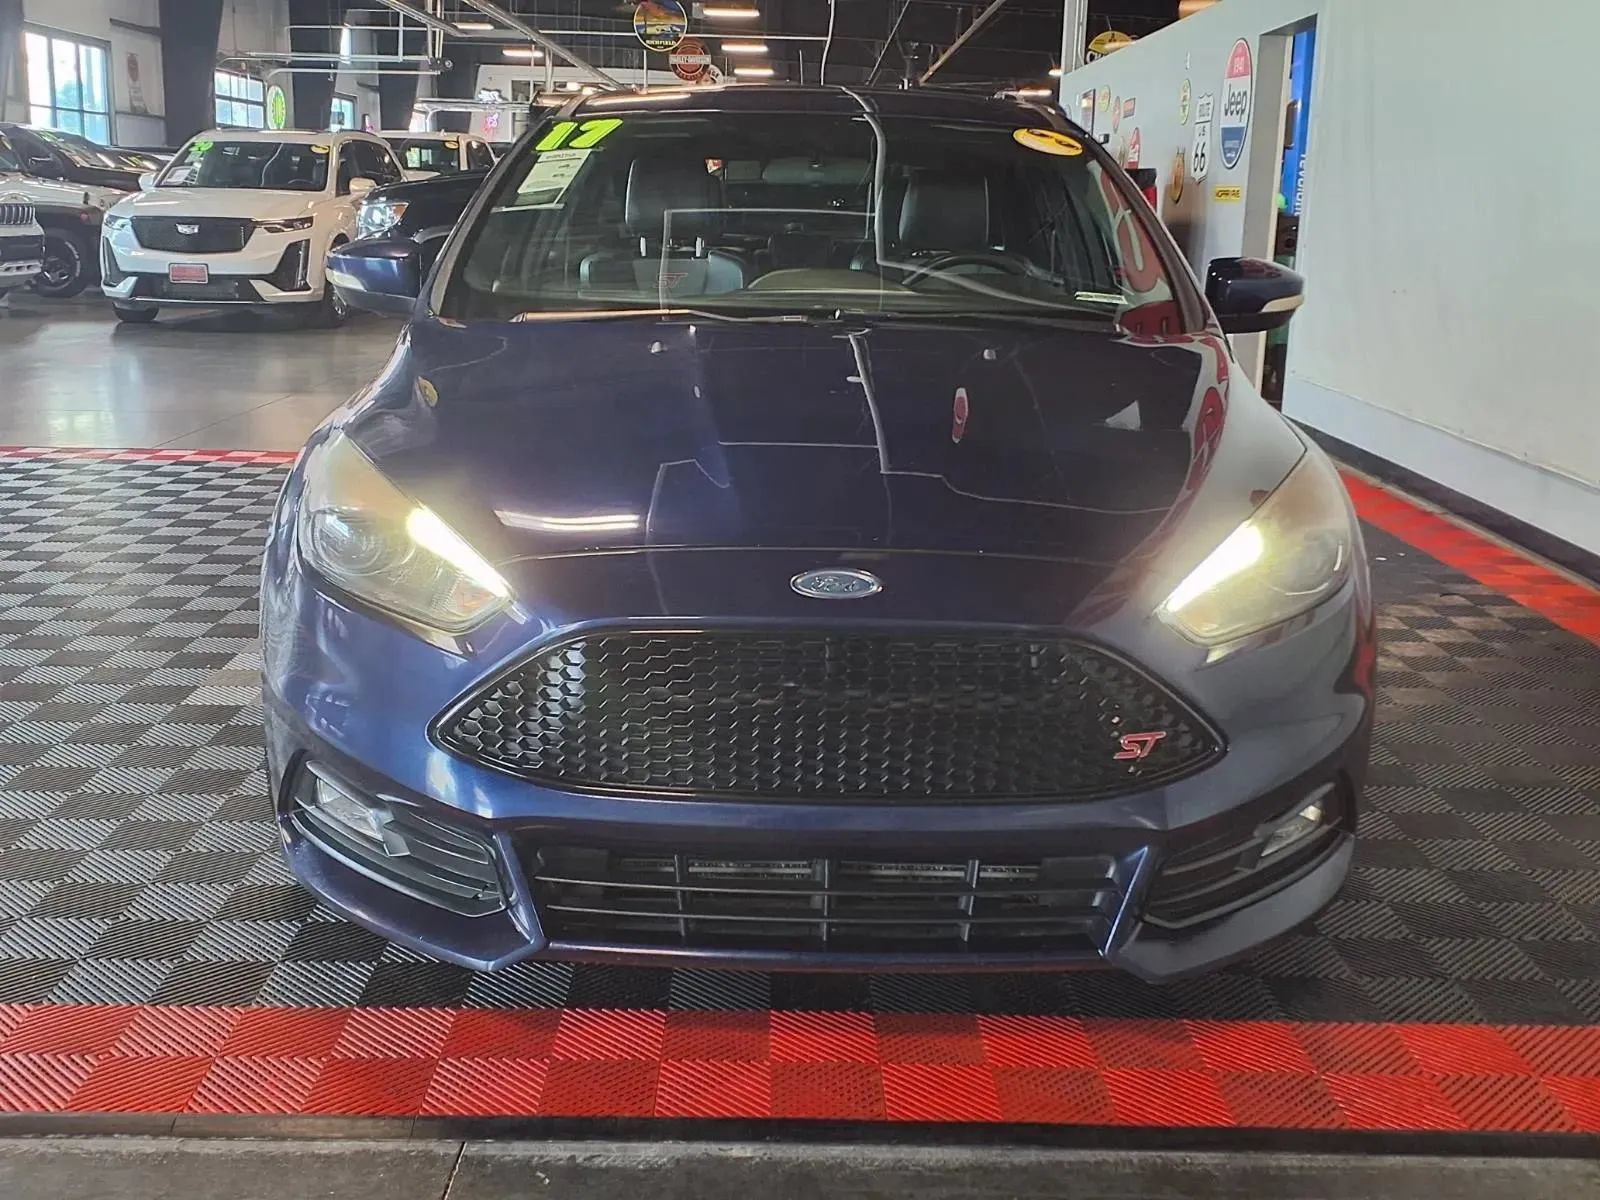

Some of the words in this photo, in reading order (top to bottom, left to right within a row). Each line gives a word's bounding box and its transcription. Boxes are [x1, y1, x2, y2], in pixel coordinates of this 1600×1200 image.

[1224, 83, 1248, 123] Jeep
[535, 118, 623, 151] 17
[1193, 142, 1206, 173] 66
[1112, 731, 1167, 760] ST
